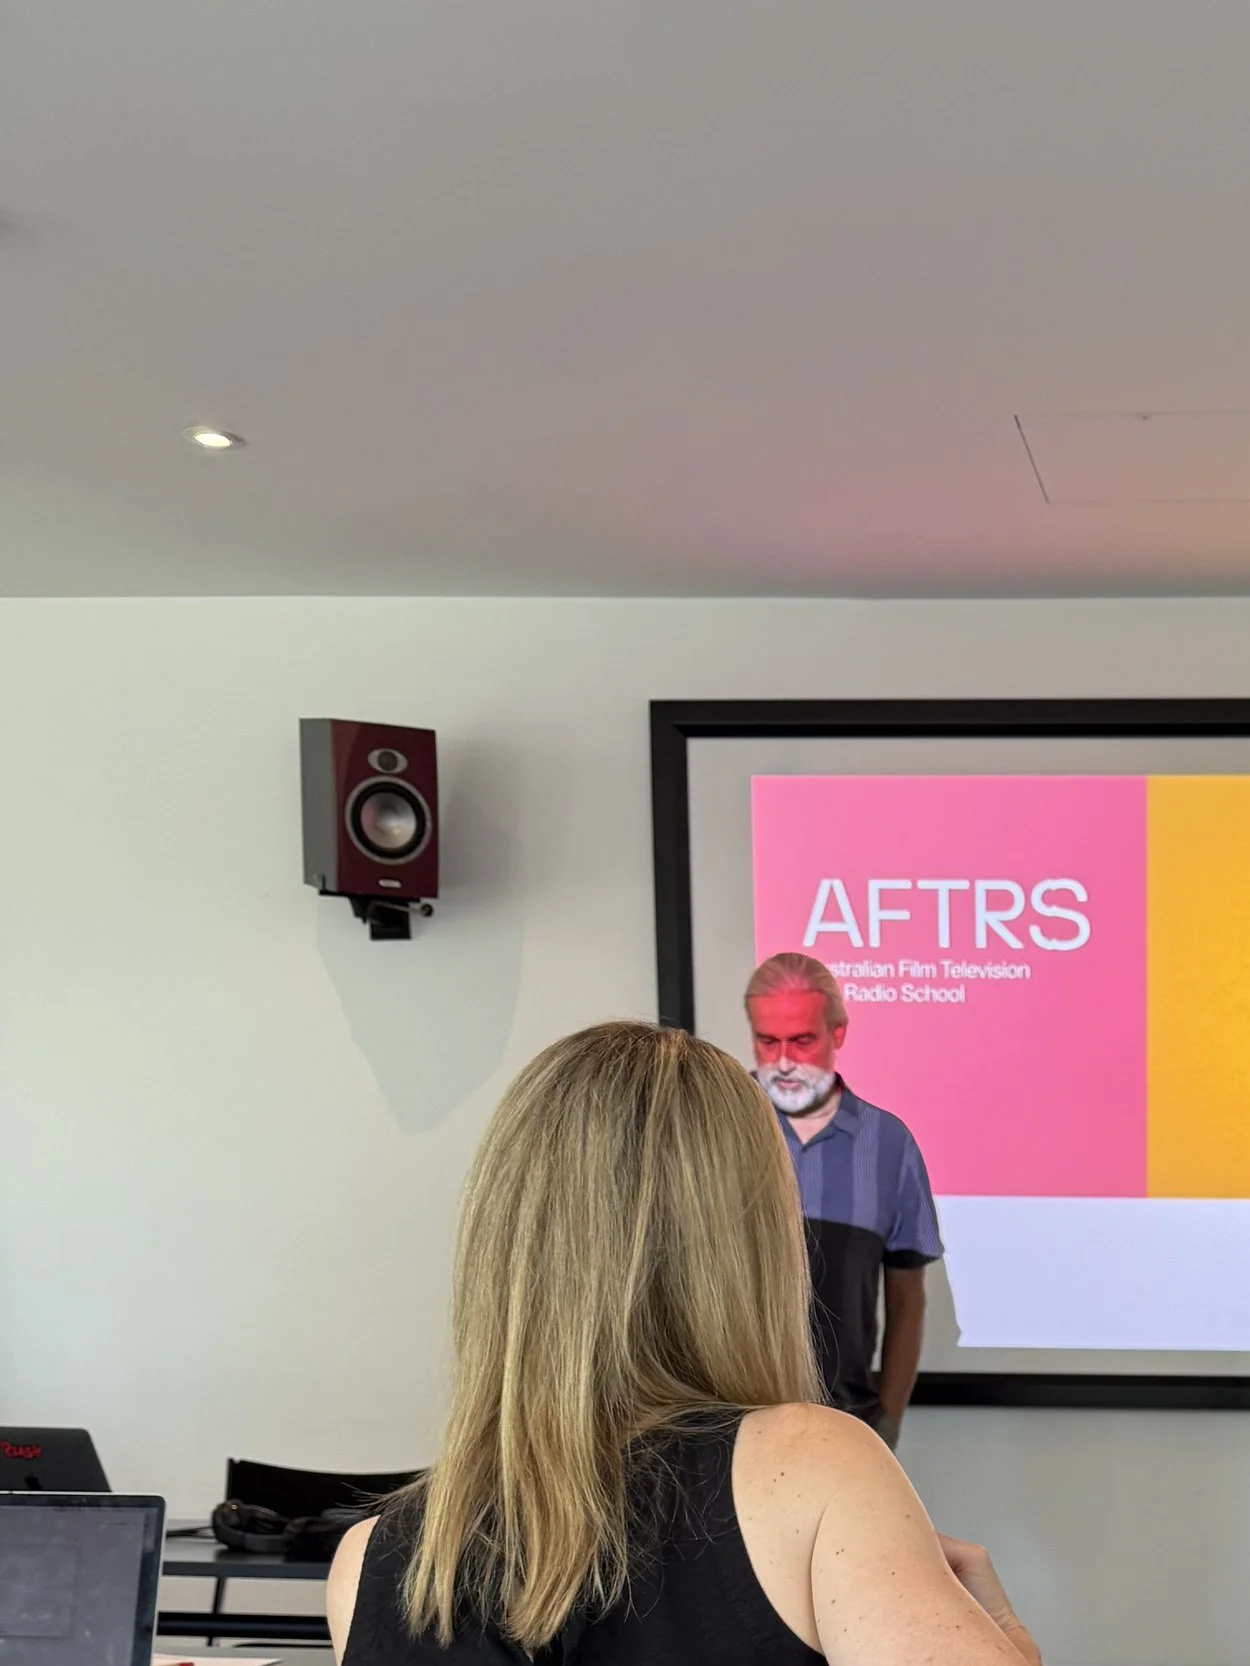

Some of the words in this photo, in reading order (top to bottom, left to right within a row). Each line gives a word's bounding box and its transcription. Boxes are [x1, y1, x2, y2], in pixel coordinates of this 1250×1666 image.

[802, 878, 1091, 951] AFTRS
[827, 959, 896, 979] stralian
[898, 959, 936, 979] Film
[940, 960, 1031, 979] Television
[844, 984, 897, 1002] Radio
[900, 984, 965, 1002] School
